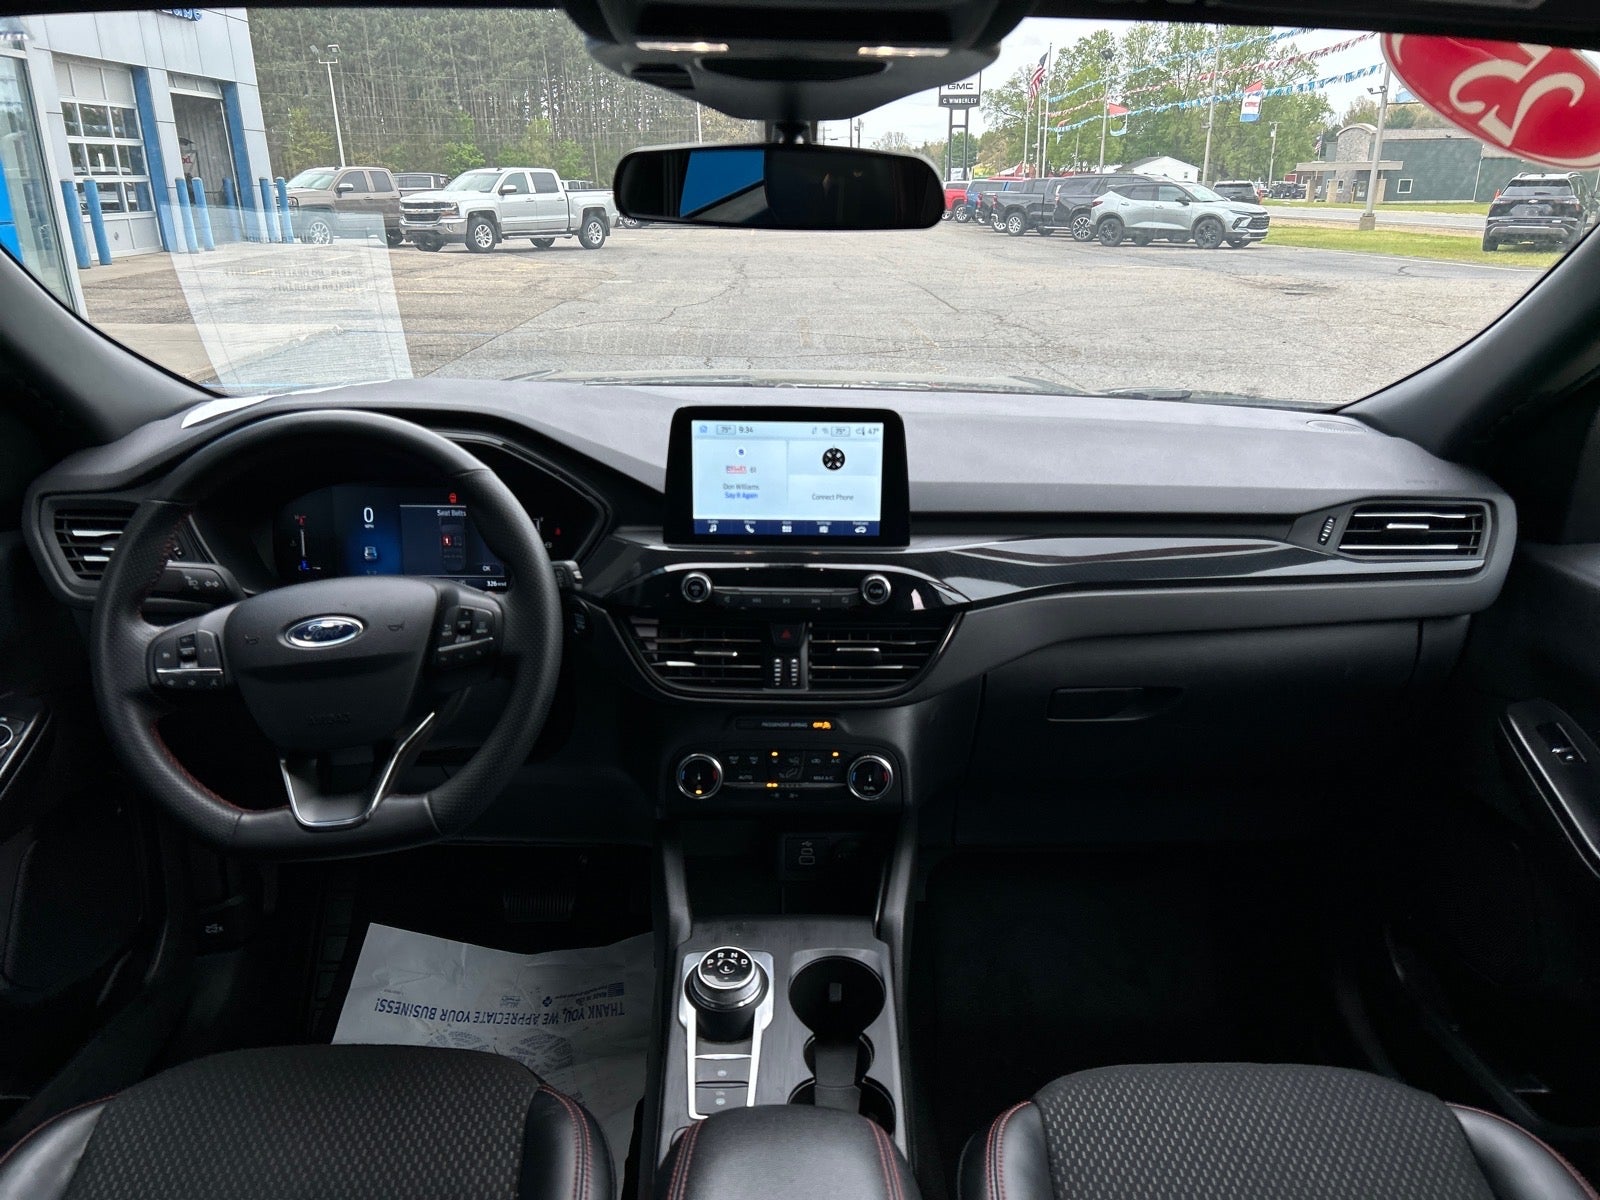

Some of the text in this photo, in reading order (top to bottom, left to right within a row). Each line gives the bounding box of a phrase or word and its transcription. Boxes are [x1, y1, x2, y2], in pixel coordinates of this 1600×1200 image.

[811, 493, 854, 501] Connect Phone
[363, 506, 374, 523] 0
[436, 509, 450, 517] Seat
[374, 997, 438, 1020] BUSINESS!
[439, 1008, 471, 1024] YOUR
[563, 1007, 585, 1023] YOU,
[588, 1002, 625, 1019] THANK
[473, 1011, 540, 1026] APPRECIATE
[542, 1013, 559, 1025] WE
